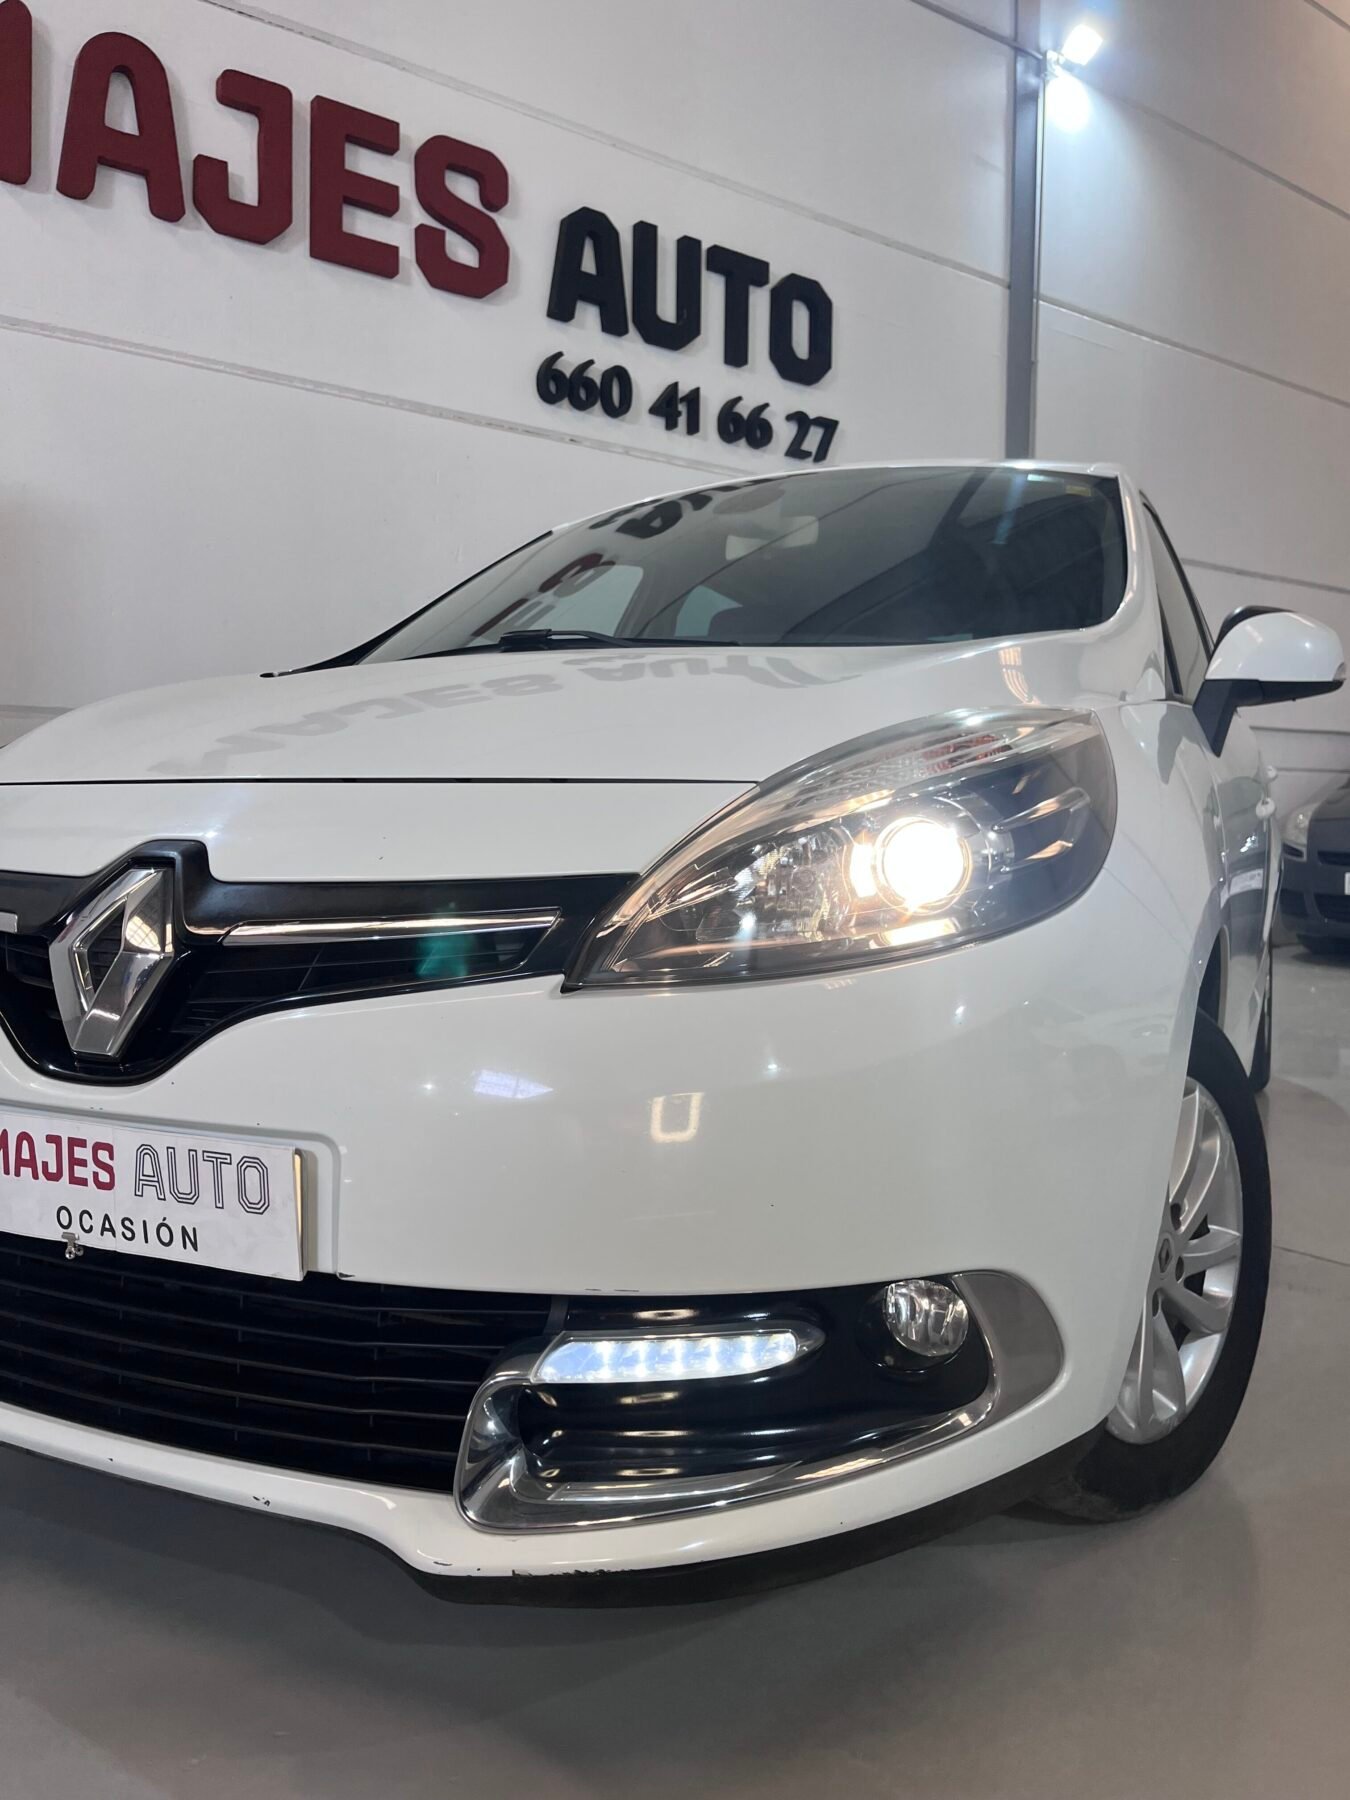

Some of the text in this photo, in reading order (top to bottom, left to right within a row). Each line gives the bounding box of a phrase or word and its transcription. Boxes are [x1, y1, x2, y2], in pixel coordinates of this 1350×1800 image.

[0, 0, 833, 386] AJES AUTO
[536, 351, 840, 463] 660 41 66 27
[134, 1143, 270, 1216] AUTO
[56, 1205, 199, 1252] OCASIÓN
